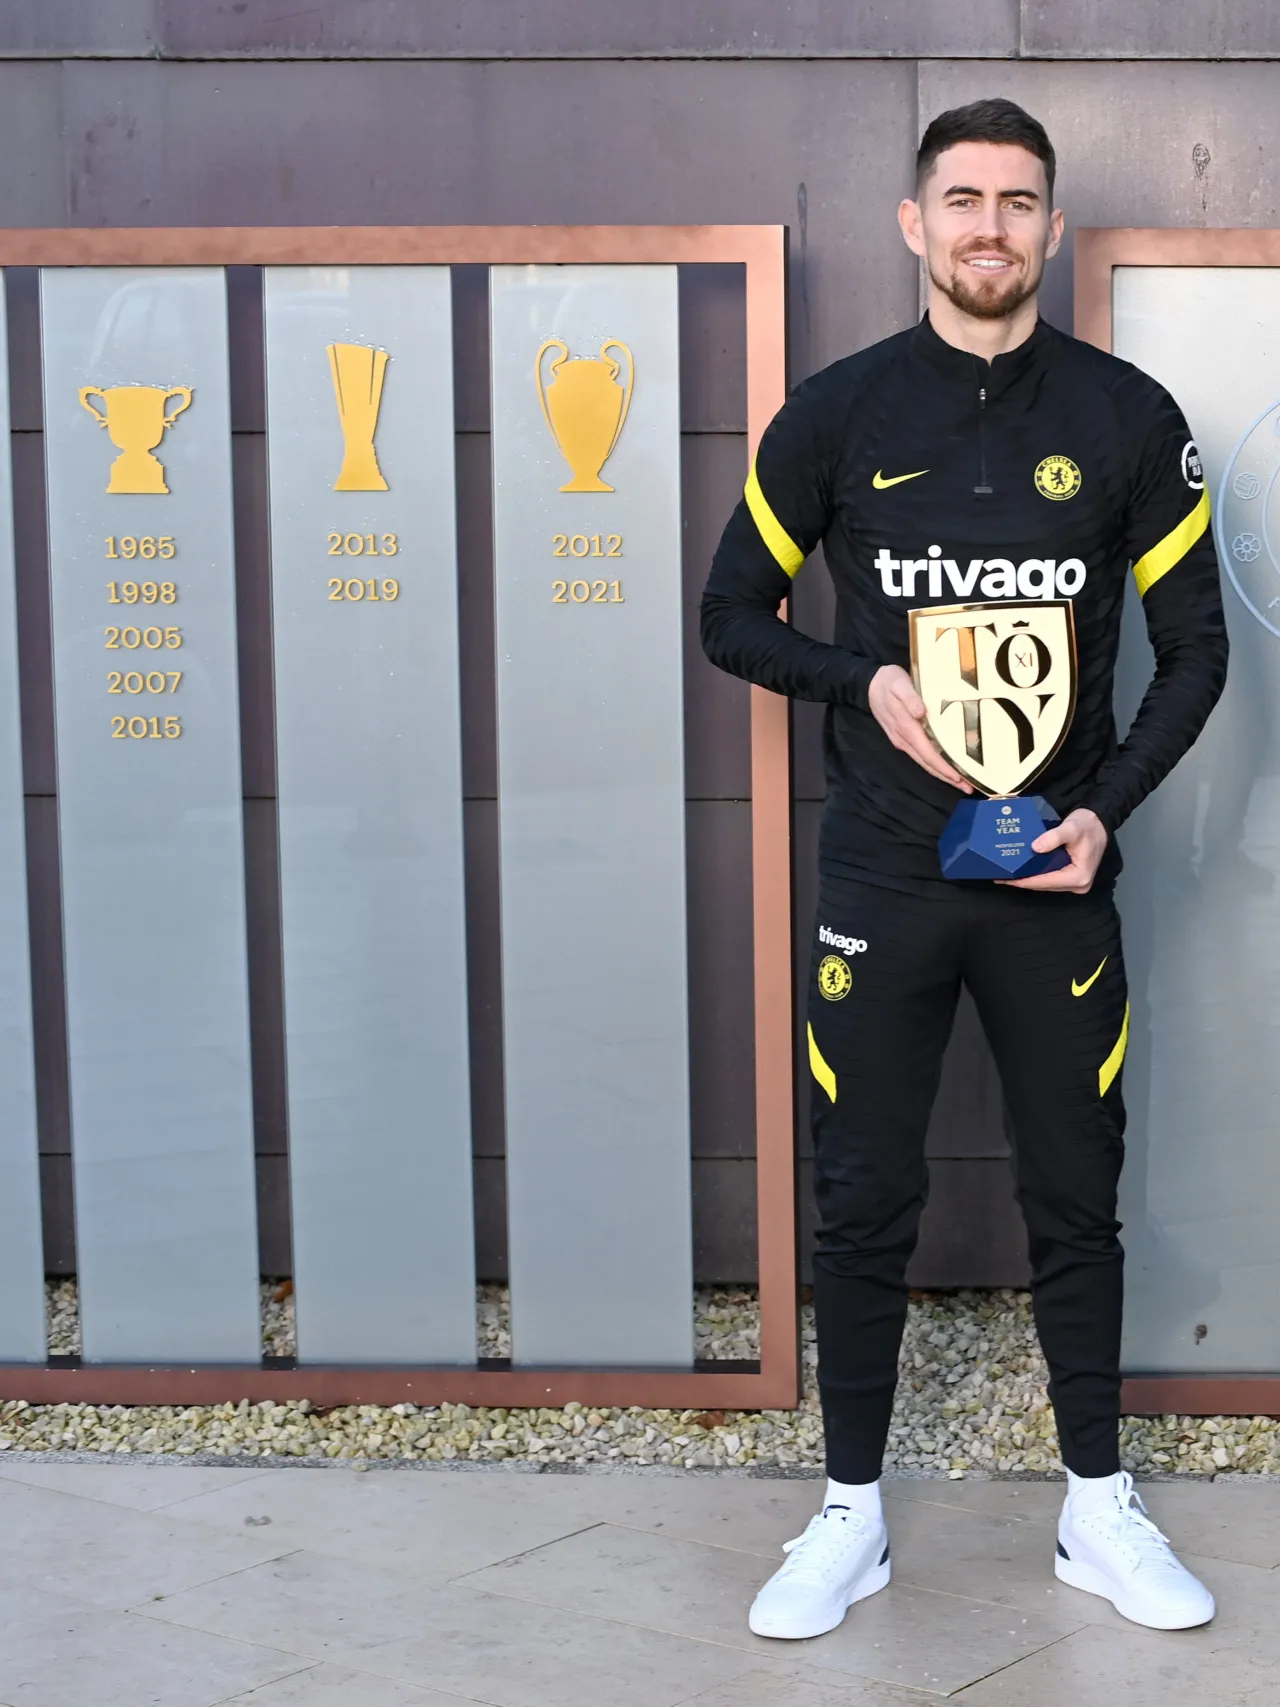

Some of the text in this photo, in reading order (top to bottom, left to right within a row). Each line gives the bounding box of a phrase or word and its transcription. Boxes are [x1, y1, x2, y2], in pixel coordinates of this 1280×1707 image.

[105, 536, 175, 559] 1965
[327, 533, 398, 556] 2013
[552, 534, 623, 557] 2012
[874, 545, 1087, 600] trivago
[107, 581, 176, 604] 1998
[328, 578, 399, 601] 2019
[552, 580, 624, 603] 2021
[105, 626, 182, 649] 2005
[107, 672, 182, 694] 2007
[111, 716, 181, 739] 2015
[995, 818, 1020, 826] TEAM
[1000, 849, 1020, 857] 2021
[819, 925, 868, 956] trivago
